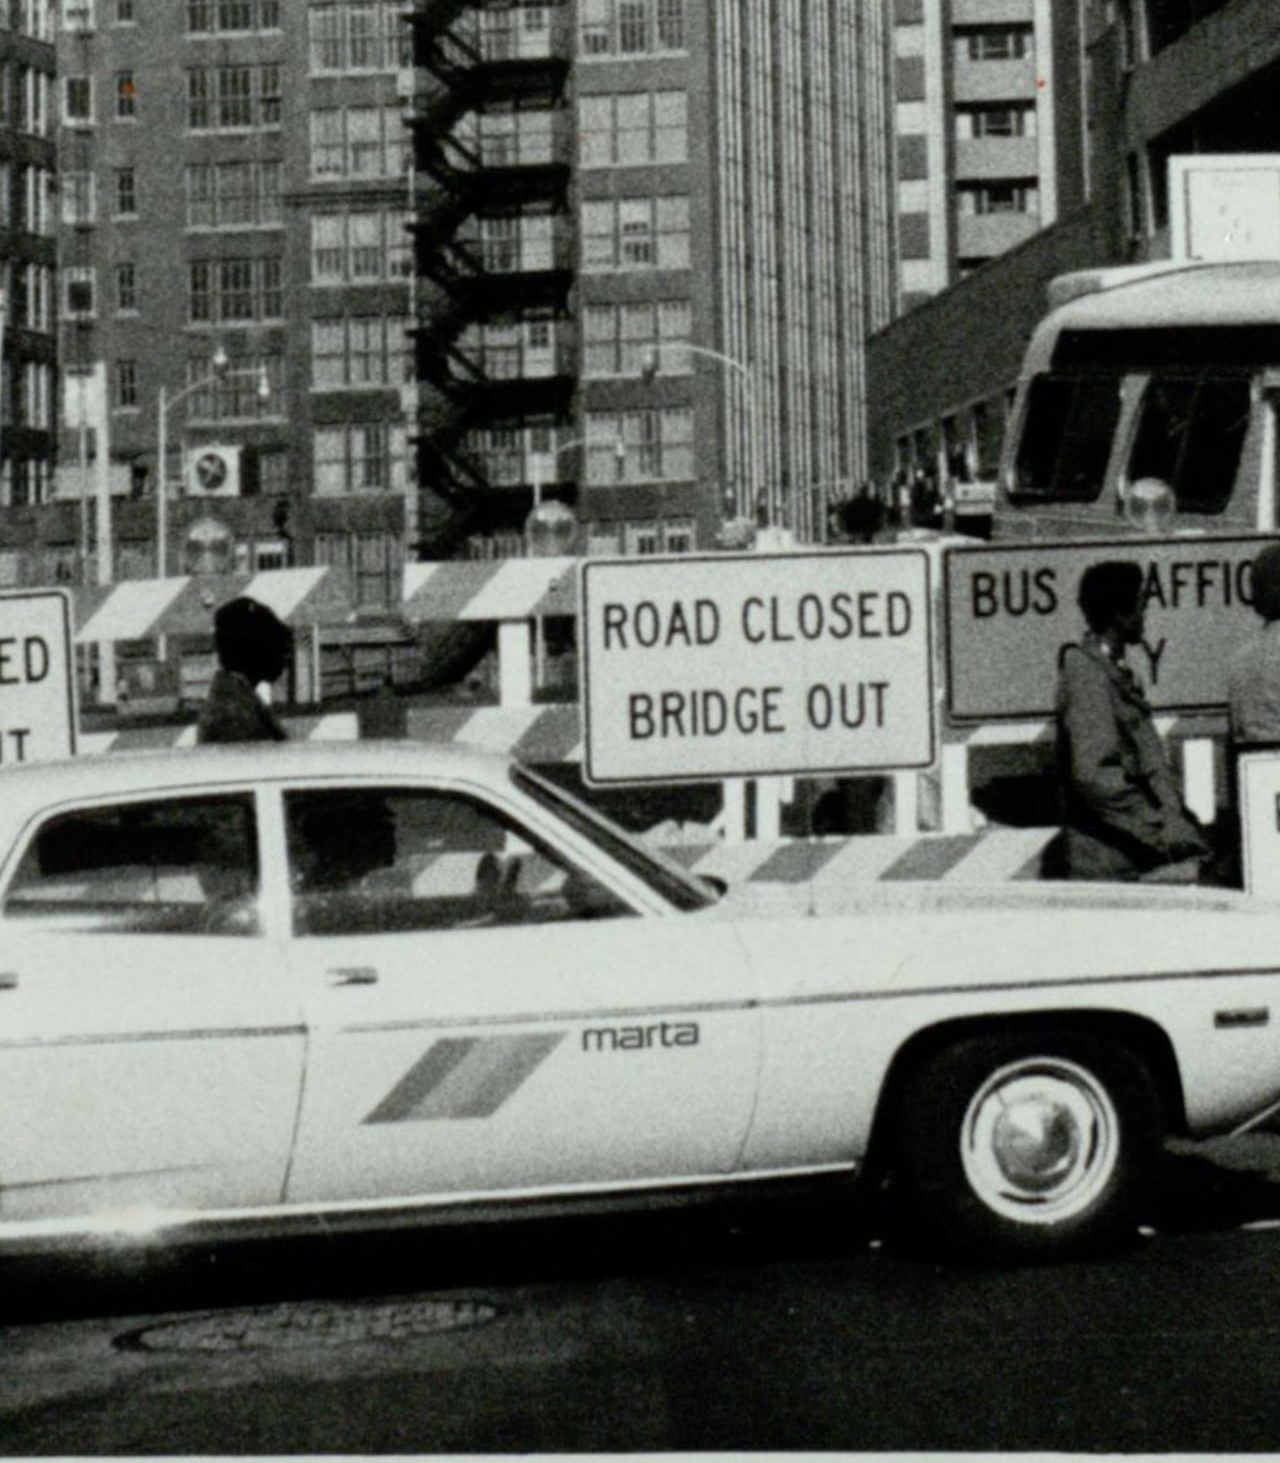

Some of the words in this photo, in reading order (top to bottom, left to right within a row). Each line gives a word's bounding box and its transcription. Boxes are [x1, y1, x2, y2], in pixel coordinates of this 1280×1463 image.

[971, 569, 1058, 618] BUS
[1142, 559, 1255, 609] AFFIC
[603, 599, 719, 649] ROAD
[741, 591, 912, 641] CLOSED
[628, 685, 786, 739] BRIDGE
[807, 682, 891, 730] OUT
[582, 1021, 701, 1053] marta
